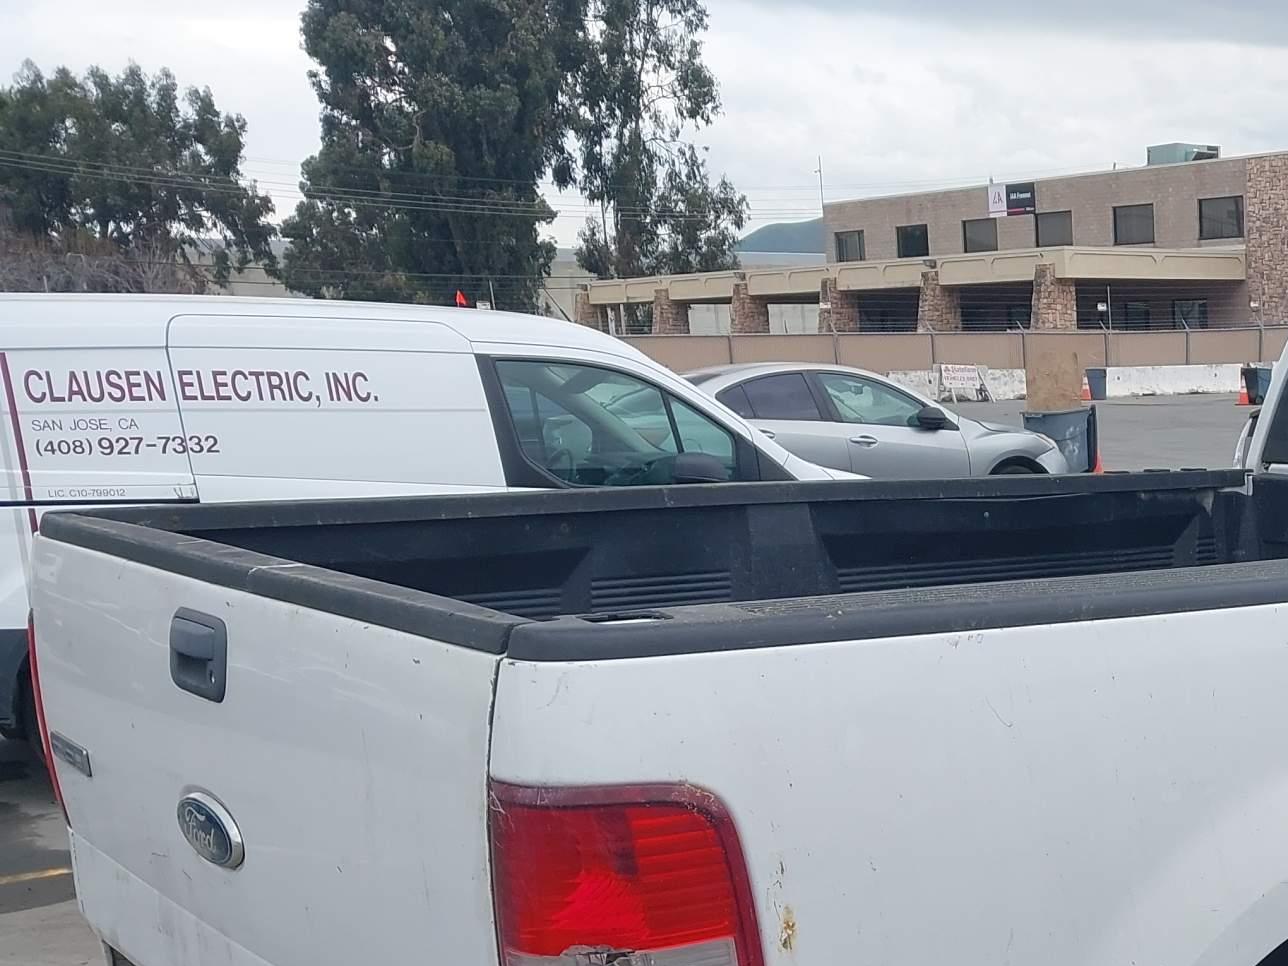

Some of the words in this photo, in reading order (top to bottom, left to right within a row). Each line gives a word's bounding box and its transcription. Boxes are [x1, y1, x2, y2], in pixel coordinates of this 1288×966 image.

[24, 370, 167, 403] CLAUSEN
[177, 370, 321, 408] ELECTRIC,
[325, 371, 379, 402] INC.
[31, 419, 62, 432] SAN
[69, 418, 113, 432] JOSE,
[118, 418, 139, 430] CA
[35, 438, 93, 457] (408)
[97, 435, 220, 455] 927-7332
[184, 806, 217, 853] Ford
